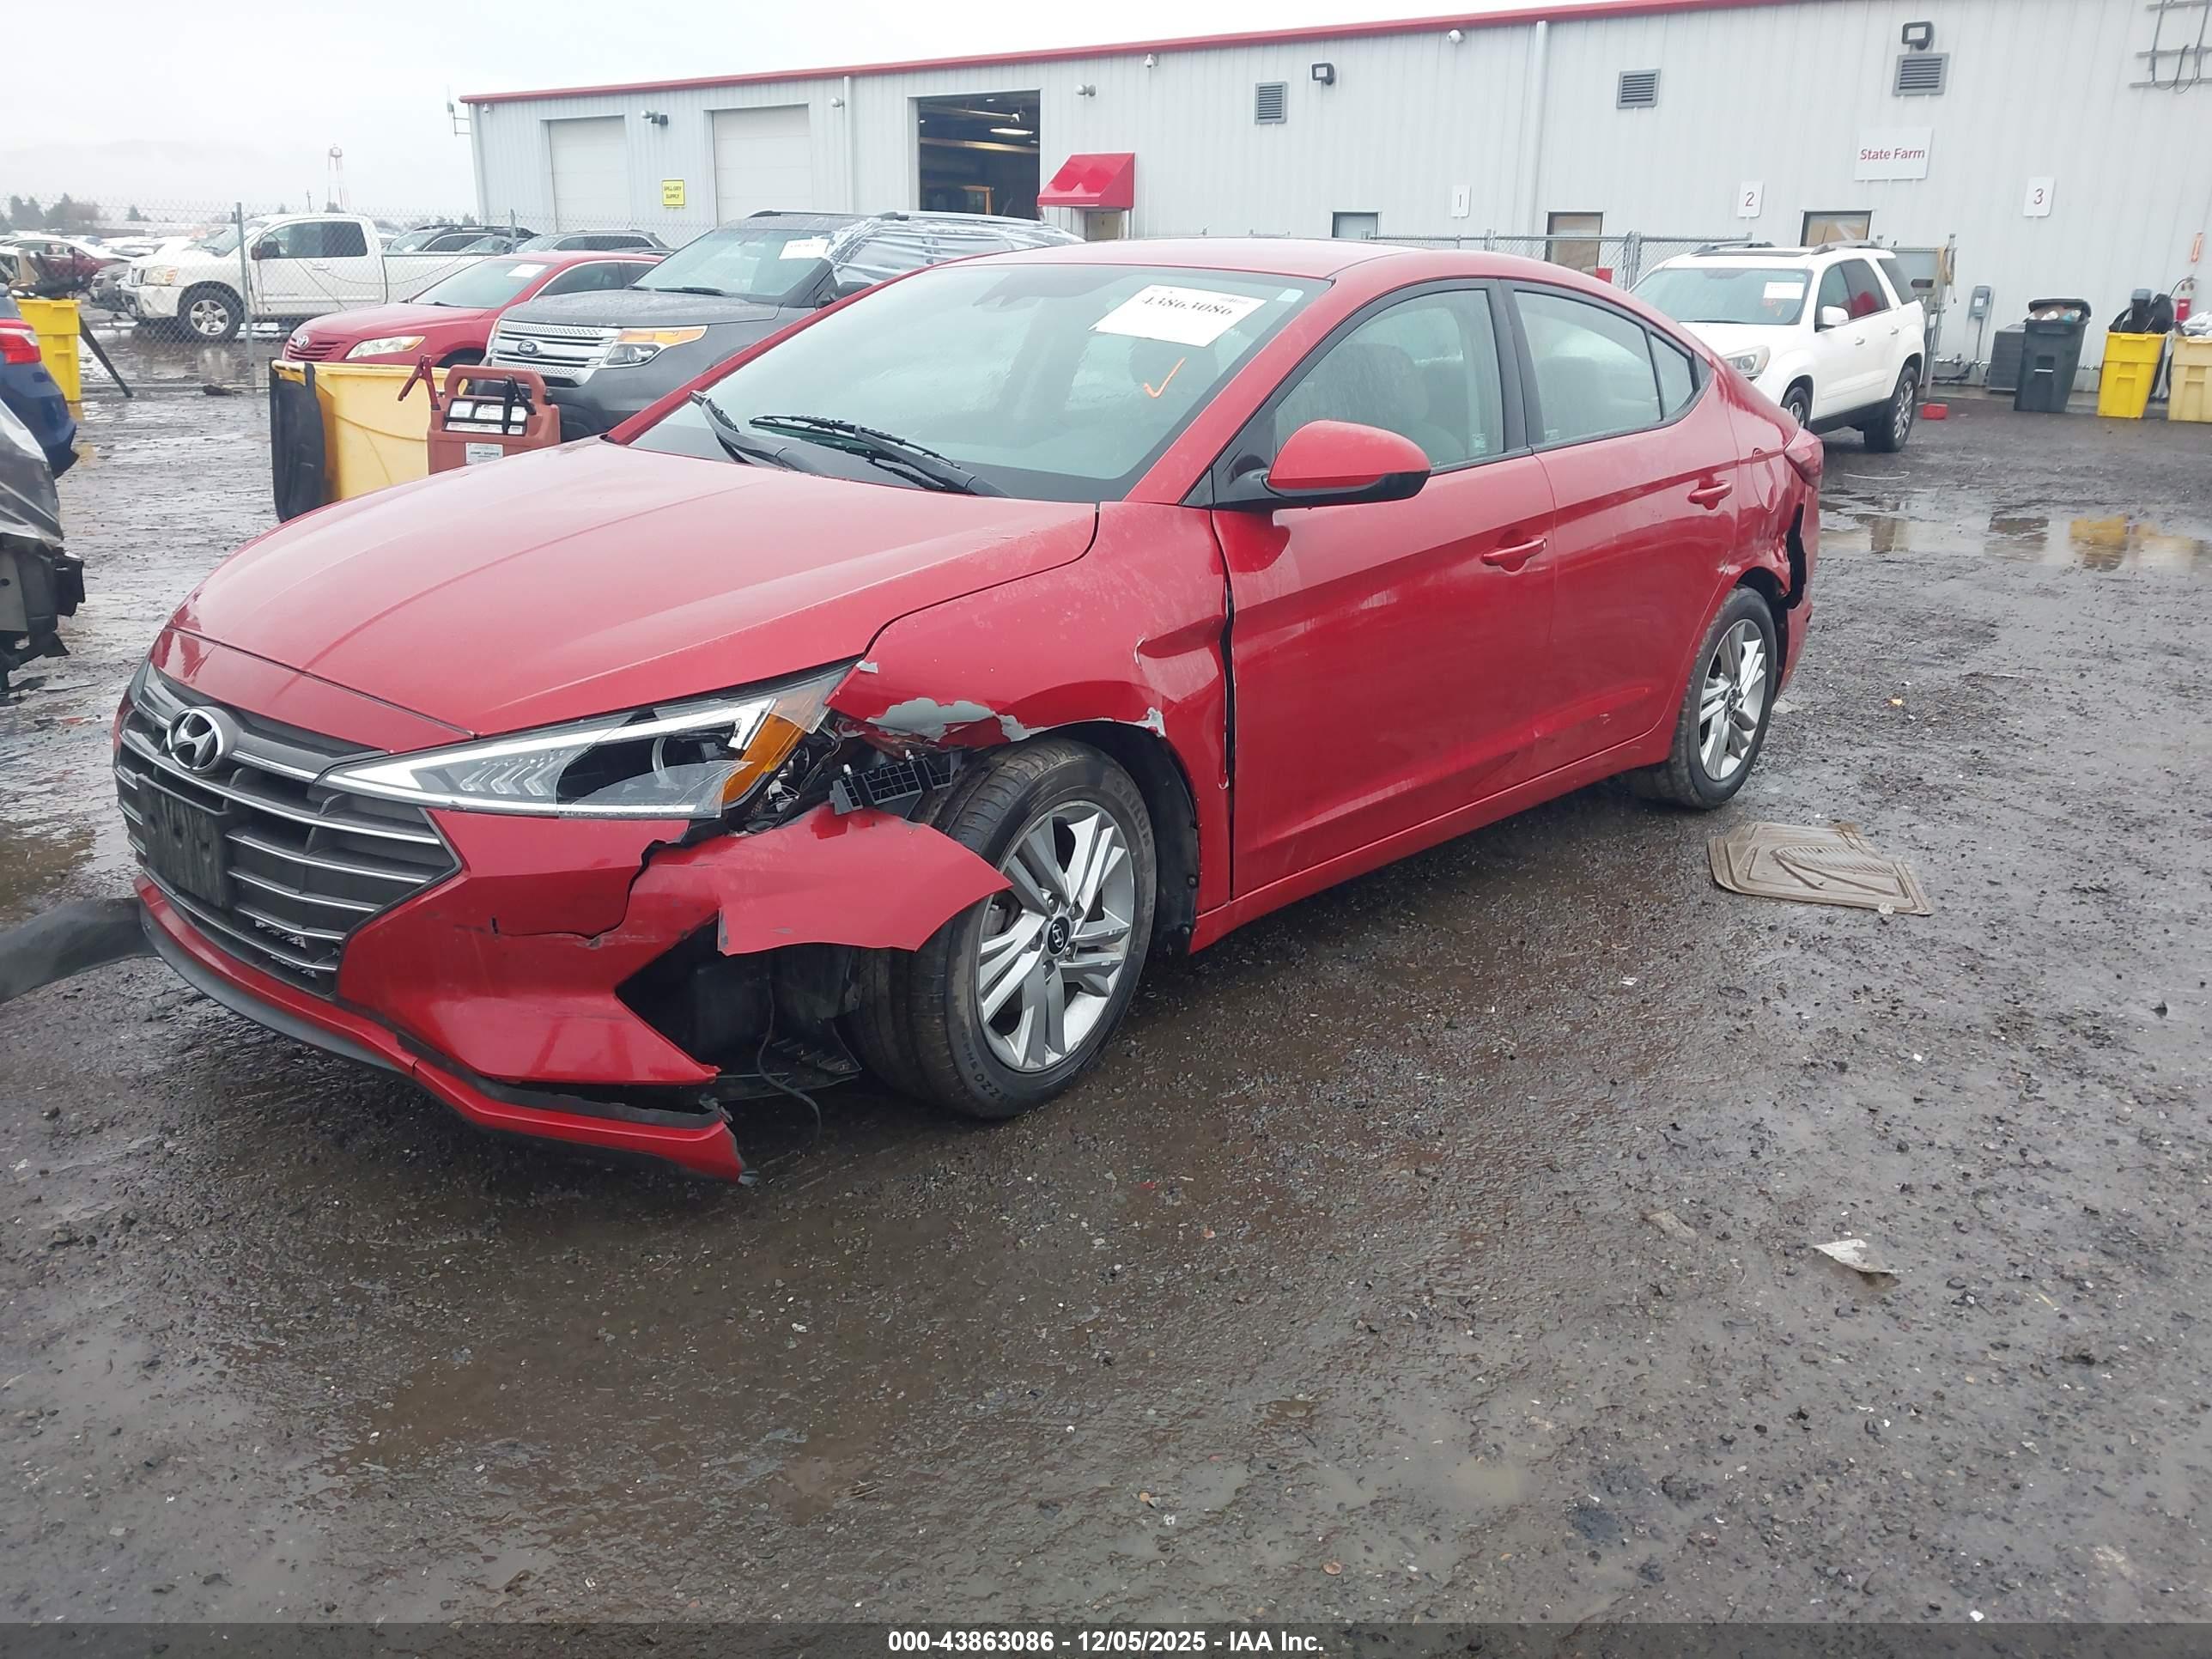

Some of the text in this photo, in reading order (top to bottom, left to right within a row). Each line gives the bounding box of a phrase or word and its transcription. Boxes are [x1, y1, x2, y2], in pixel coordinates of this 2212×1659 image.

[1859, 147, 1925, 161] State Farm
[1745, 191, 1754, 207] 2
[2033, 188, 2044, 205] 3
